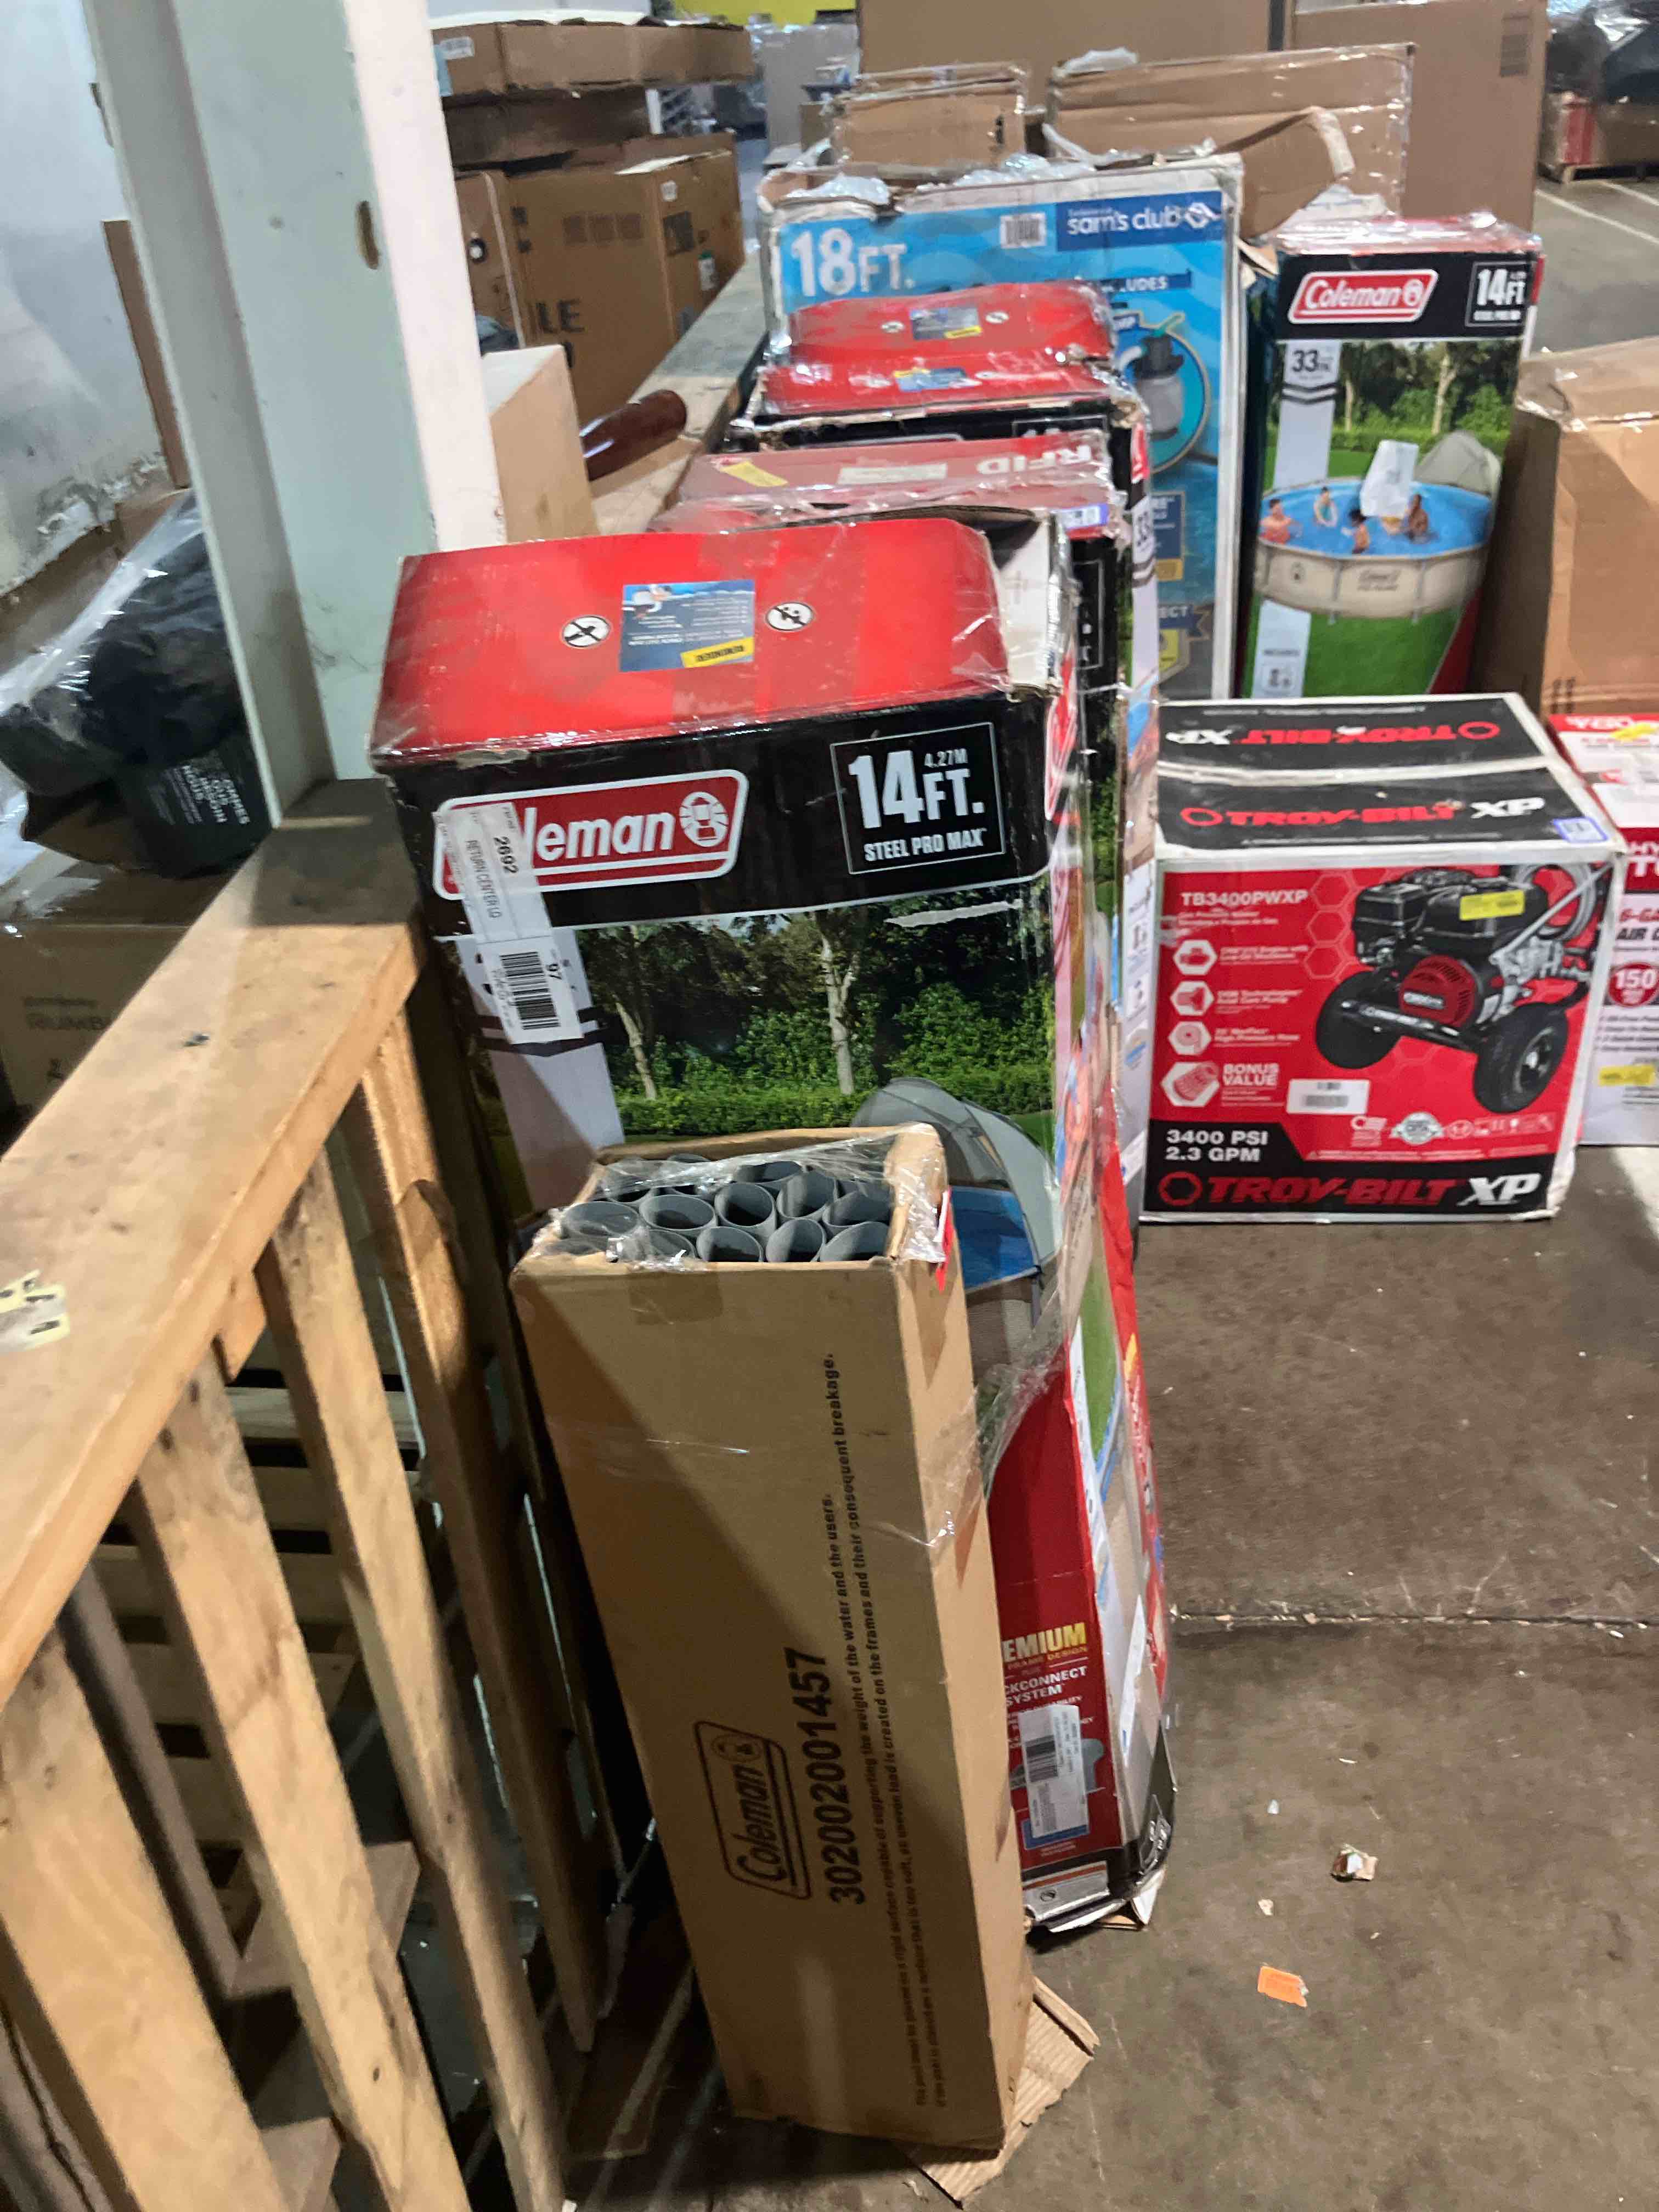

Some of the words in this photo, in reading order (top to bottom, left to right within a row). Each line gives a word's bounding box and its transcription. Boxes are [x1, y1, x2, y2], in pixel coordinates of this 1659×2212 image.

[1067, 211, 1128, 235] sam's
[1132, 205, 1180, 230] club
[1124, 276, 1169, 292] UDES
[1305, 280, 1403, 311] Coleman
[1166, 724, 1248, 746] XP
[924, 748, 969, 768] 4.27M
[1225, 800, 1458, 826] TROY-BILT
[1470, 797, 1546, 819] XP
[523, 807, 676, 861] leman
[864, 839, 909, 862] STEEL
[911, 833, 945, 855] PRO
[465, 840, 487, 872] RETURN
[476, 873, 498, 905] CENTER
[1181, 889, 1309, 906] TB3400PWXP
[1615, 968, 1657, 990] 150
[1223, 1063, 1280, 1075] BONUS
[1223, 1074, 1279, 1086] VALUE
[1166, 1130, 1223, 1145] 3400
[1231, 1130, 1268, 1145] PSI
[1165, 1147, 1201, 1161] 2.3
[1206, 1146, 1261, 1161] GPM
[1207, 1177, 1460, 1204] TROY-BILT
[1455, 1173, 1542, 1207] XP
[822, 1352, 845, 1436] breakage.
[834, 1439, 860, 1531] consequent
[821, 1493, 837, 1541] users.
[827, 1544, 842, 1568] the
[849, 1533, 866, 1568] their
[831, 1571, 848, 1598] and
[853, 1571, 871, 1598] and
[837, 1600, 854, 1641] water
[860, 1600, 879, 1651] frames
[844, 1645, 858, 1667] the
[1001, 1622, 1086, 1663] EMIUM
[847, 1669, 861, 1683] of
[866, 1654, 882, 1676] the
[873, 1678, 886, 1695] on
[1005, 1666, 1088, 1694] CKCONNECT
[851, 1686, 868, 1732] weight
[873, 1698, 894, 1750] created
[859, 1735, 873, 1757] the
[881, 1752, 895, 1764] is
[782, 1646, 866, 1905] 302002001457
[883, 1764, 900, 1793] load
[865, 1758, 883, 1825] supporting
[728, 1764, 786, 1882] Coleman
